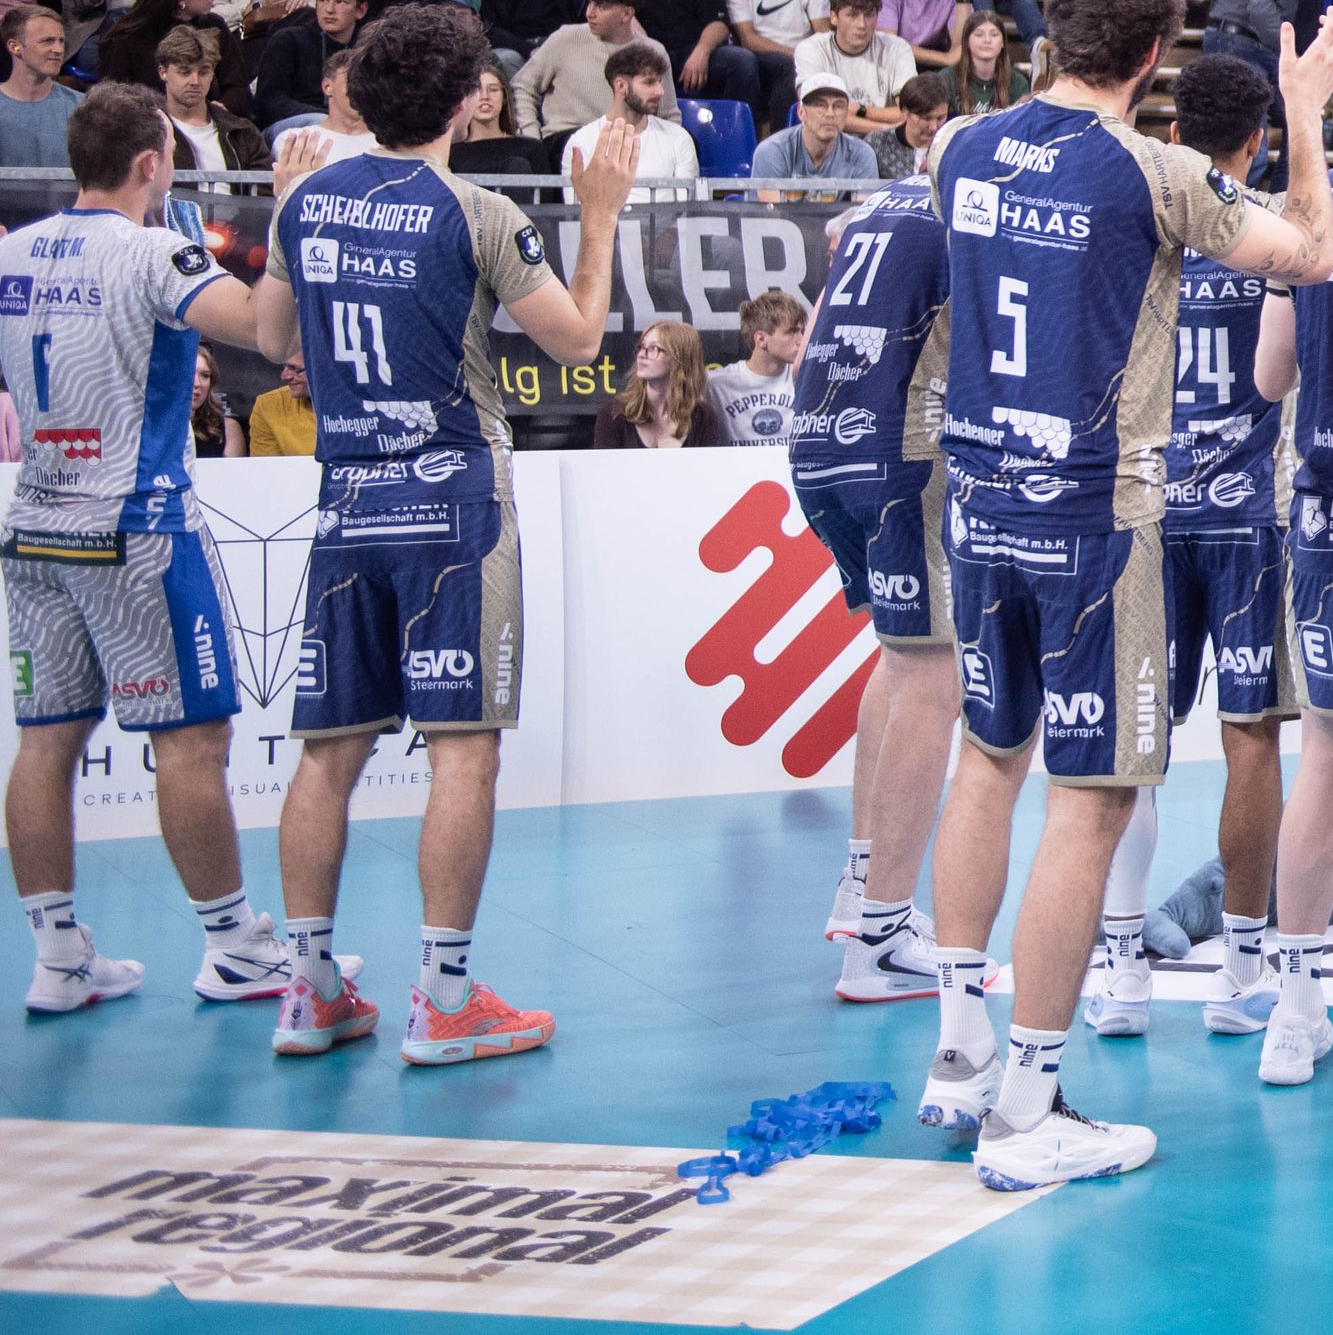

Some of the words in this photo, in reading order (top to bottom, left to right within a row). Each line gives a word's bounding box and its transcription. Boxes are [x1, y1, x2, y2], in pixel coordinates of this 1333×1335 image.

[993, 136, 1061, 174] MARKS
[299, 193, 434, 234] SCHEIBLHOFER
[955, 210, 993, 227] UNIQA
[1000, 203, 1091, 239] HAAS
[1004, 190, 1094, 213] GeneralAgentur
[304, 264, 335, 277] UNIQA
[341, 254, 417, 279] HAAS
[828, 232, 893, 306] 21
[34, 287, 102, 306] HAAS
[332, 300, 393, 386] 41
[990, 275, 1029, 377] 5
[1178, 326, 1235, 404] 24
[323, 414, 380, 440] Hochegger
[341, 513, 414, 526] Baugesellschaft
[494, 644, 513, 706] nine
[1136, 682, 1156, 755] nine
[83, 1168, 698, 1225] maximal
[67, 1208, 673, 1265] regional
